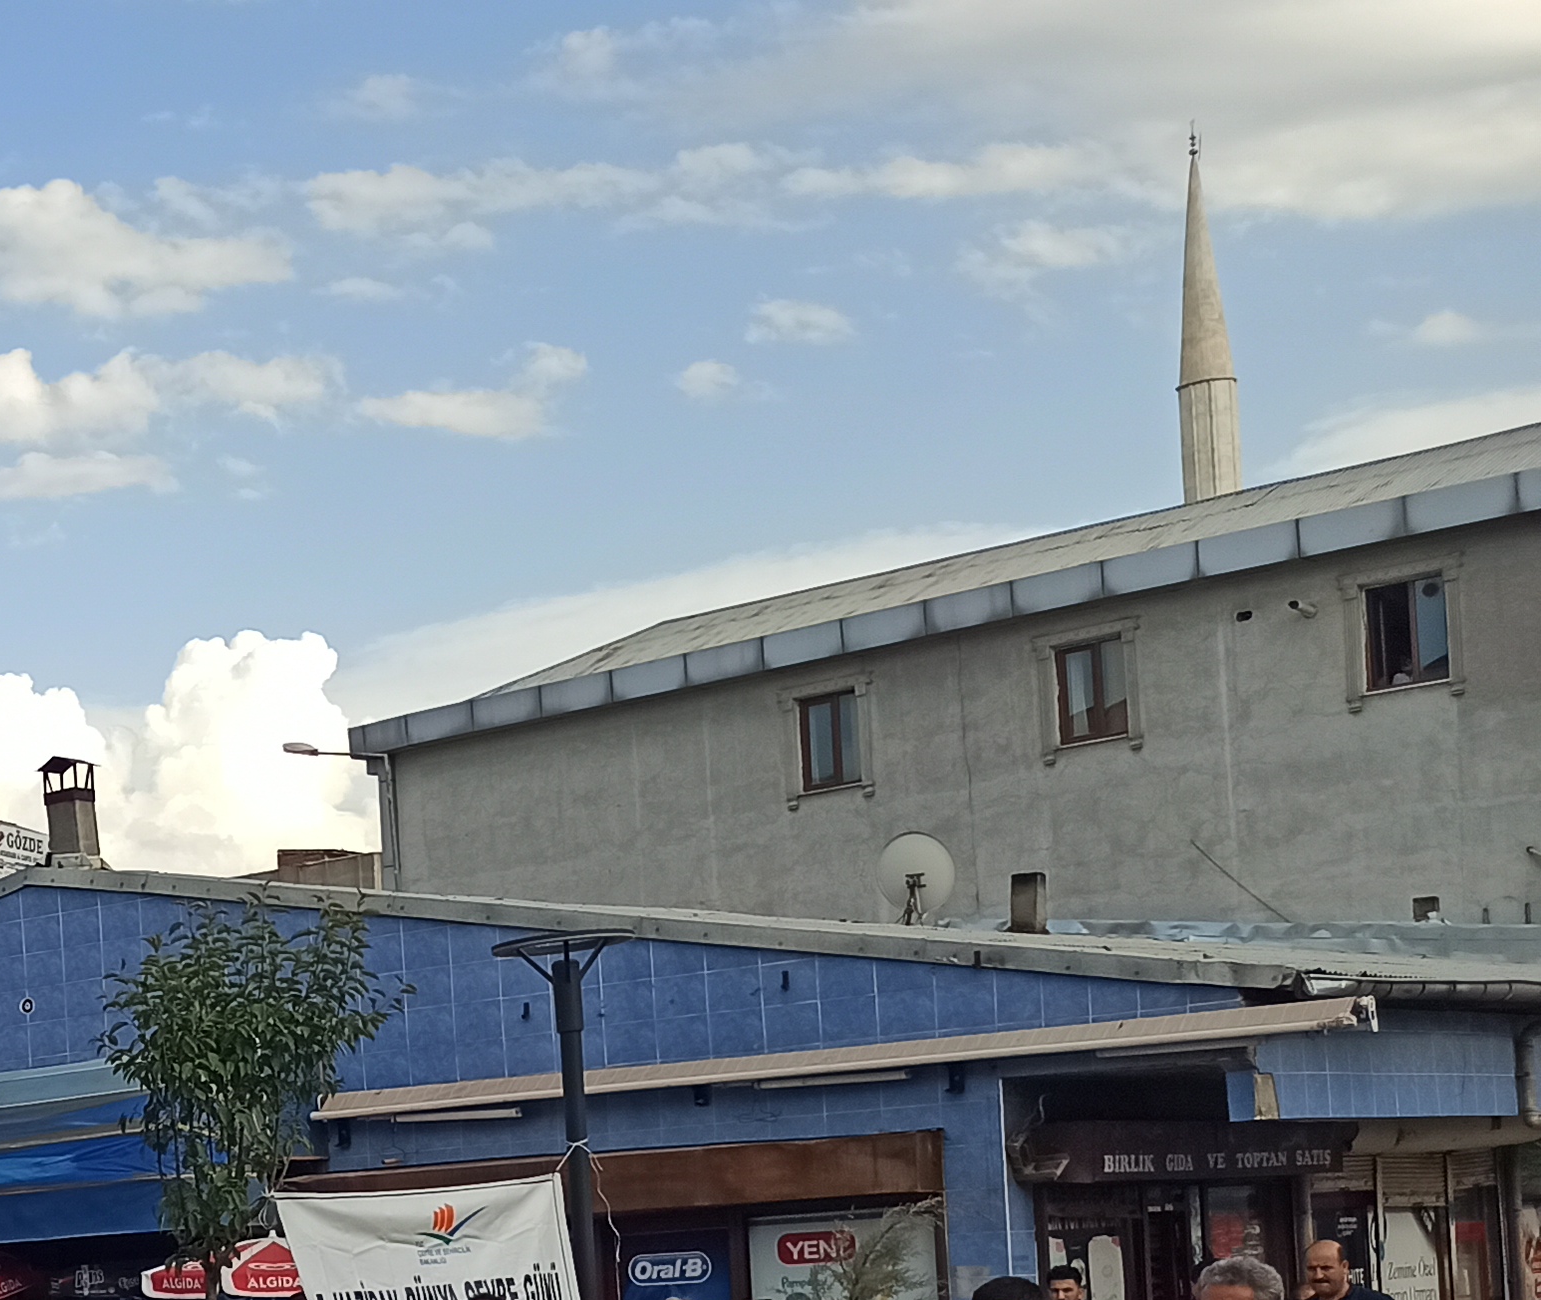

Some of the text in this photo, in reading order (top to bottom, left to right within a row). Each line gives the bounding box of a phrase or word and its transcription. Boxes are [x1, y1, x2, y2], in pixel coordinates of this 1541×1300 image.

[6, 830, 44, 854] GÖZDE
[1236, 1152, 1287, 1169] TOPTAN
[634, 1256, 703, 1281] Oral-B
